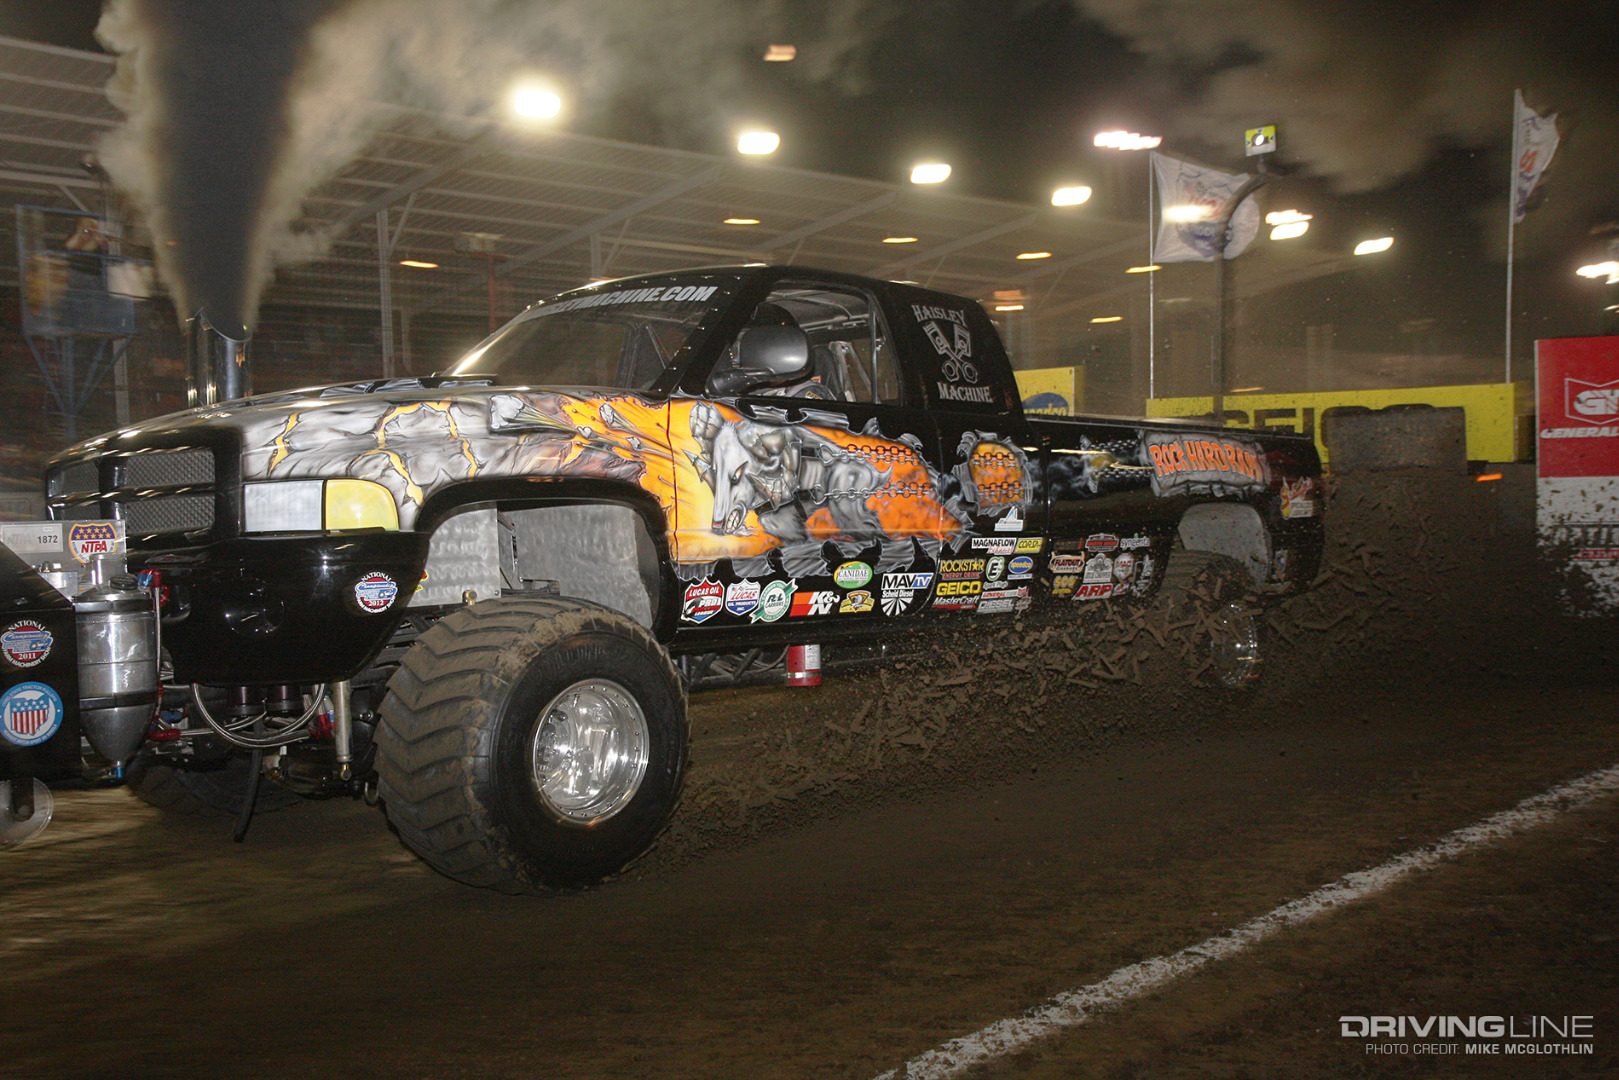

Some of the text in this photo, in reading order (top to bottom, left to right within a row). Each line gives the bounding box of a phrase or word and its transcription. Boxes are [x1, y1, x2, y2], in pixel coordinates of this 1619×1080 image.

[911, 305, 968, 328] HAISLEY
[937, 382, 994, 403] MACHINE
[1149, 440, 1260, 481] ROCK HARD RAM
[37, 535, 58, 544] 1872
[973, 539, 1016, 547] MAGNAFLOW
[81, 540, 108, 553] NTPA
[361, 572, 392, 583] NATIONAL
[839, 570, 868, 578] CANIDAE
[688, 586, 720, 597] LUCAS OIL
[900, 589, 914, 598] Diesel
[936, 581, 982, 596] GEICO
[1075, 584, 1113, 597] ARP
[731, 590, 757, 600] LUCAS
[933, 595, 980, 605] MasterCraft
[8, 620, 46, 633] NATIONAL
